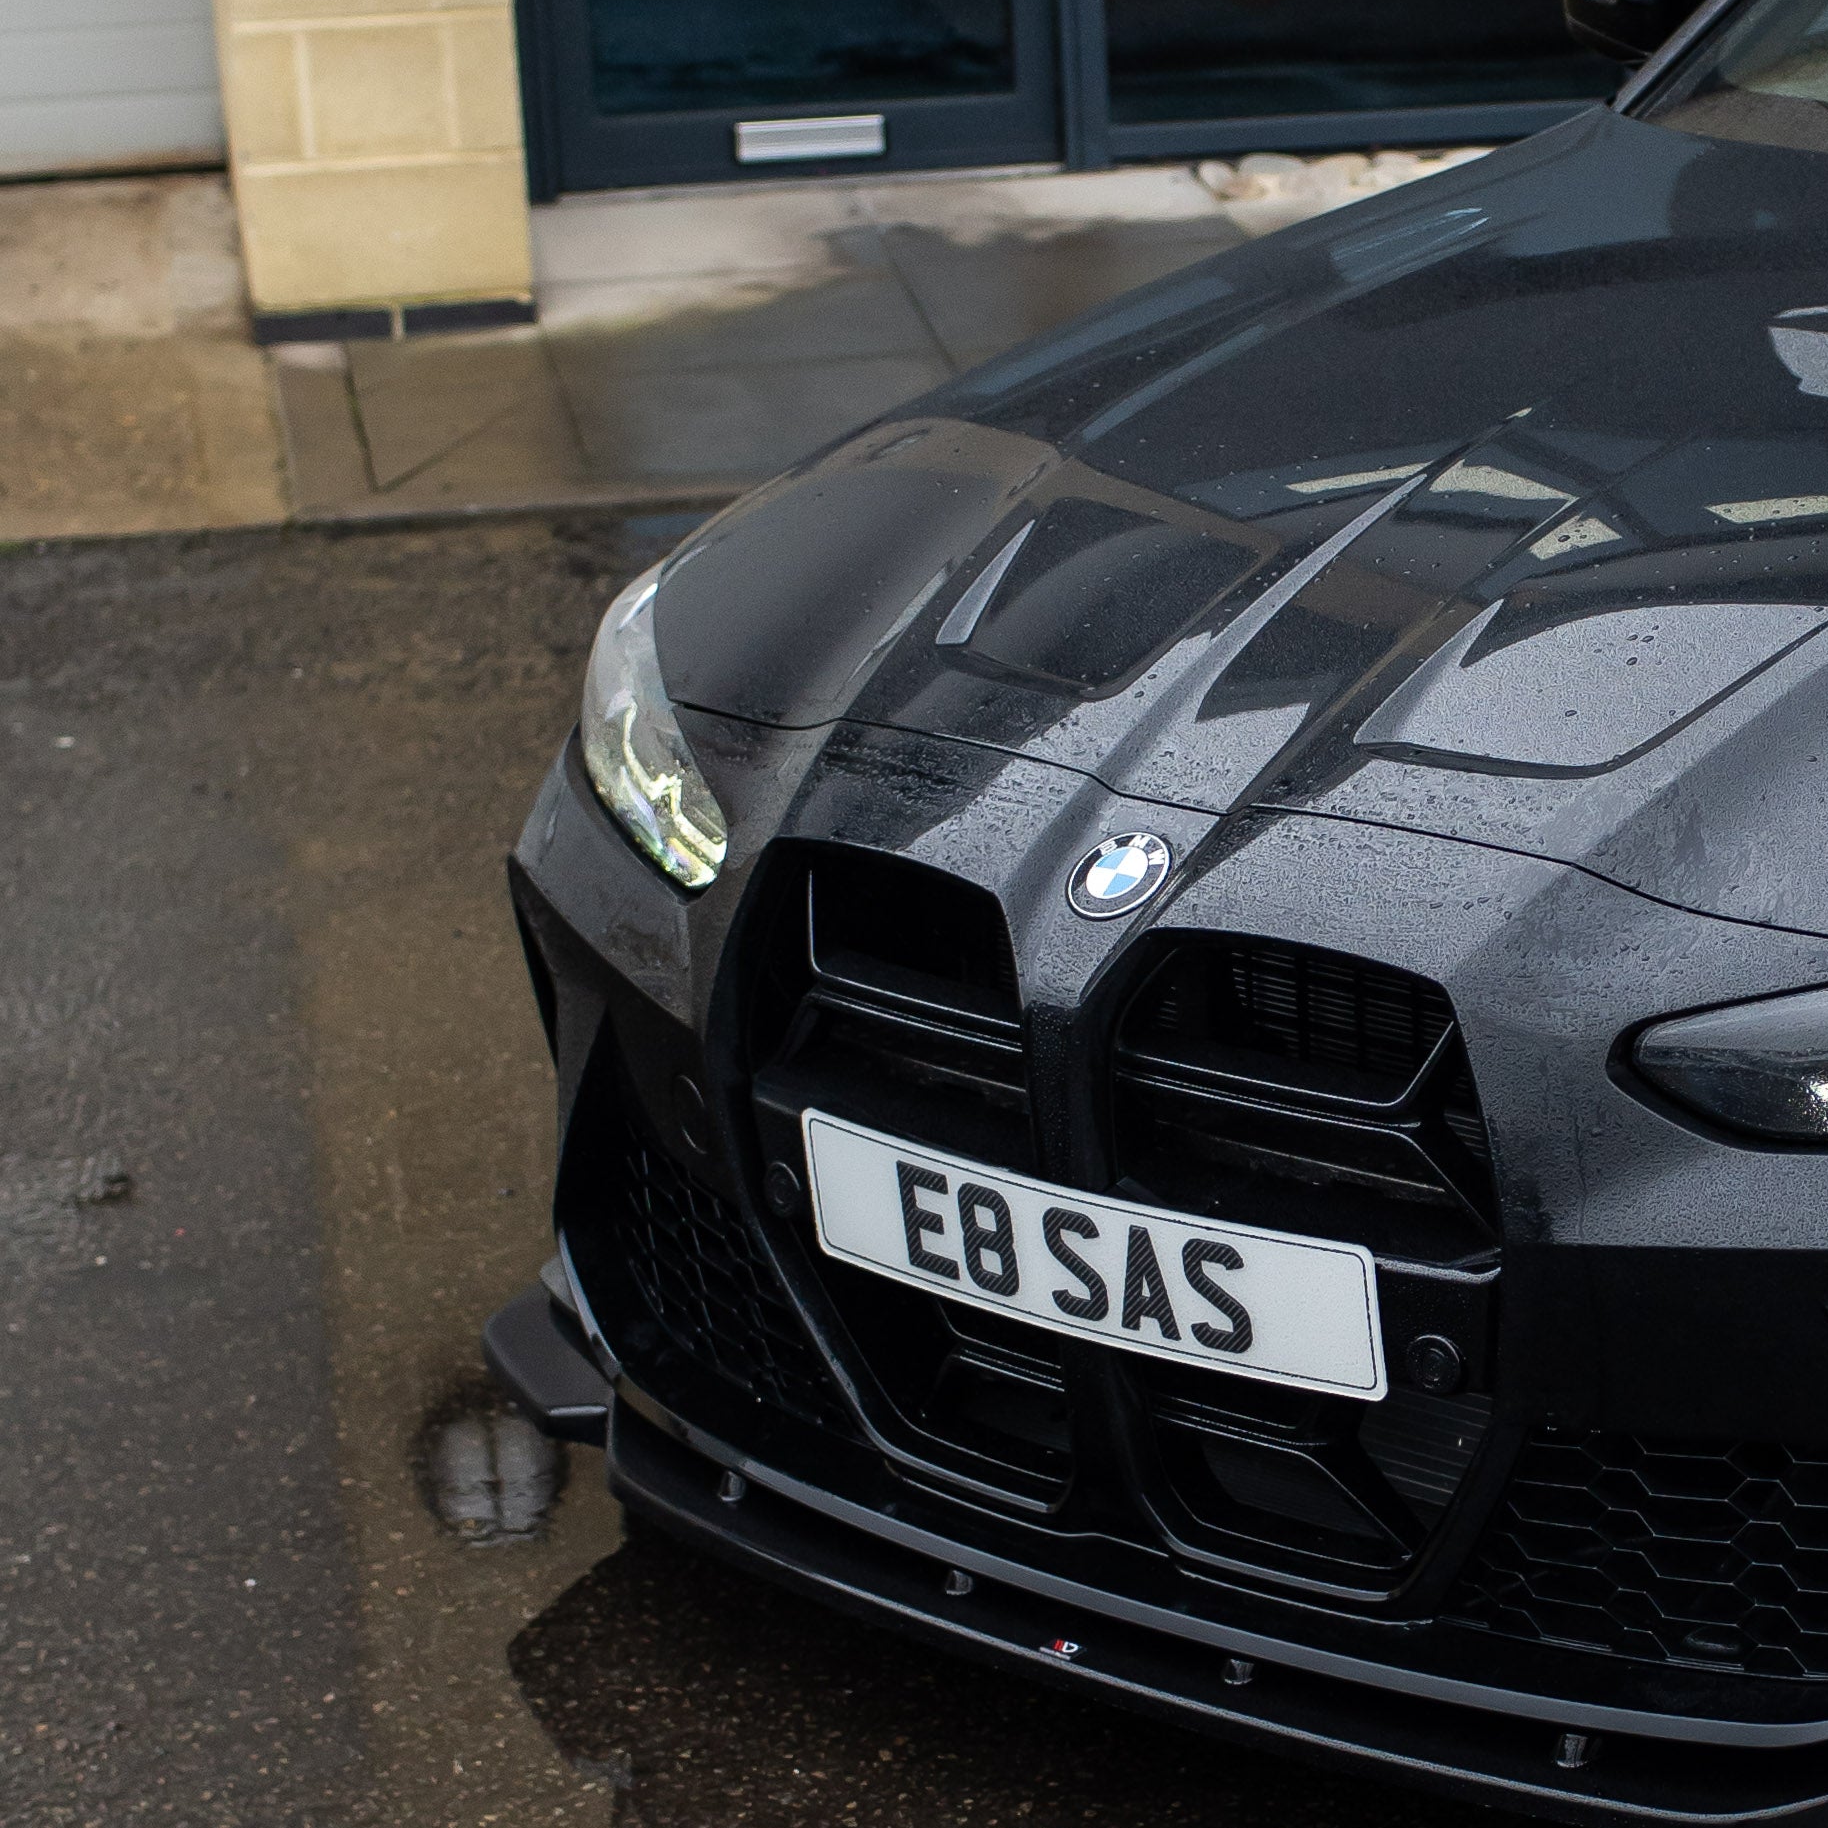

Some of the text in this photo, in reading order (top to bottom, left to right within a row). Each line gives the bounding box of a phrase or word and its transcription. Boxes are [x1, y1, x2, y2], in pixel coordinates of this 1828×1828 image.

[1099, 834, 1166, 866] BMW
[895, 1159, 1253, 1354] E8 SAS
